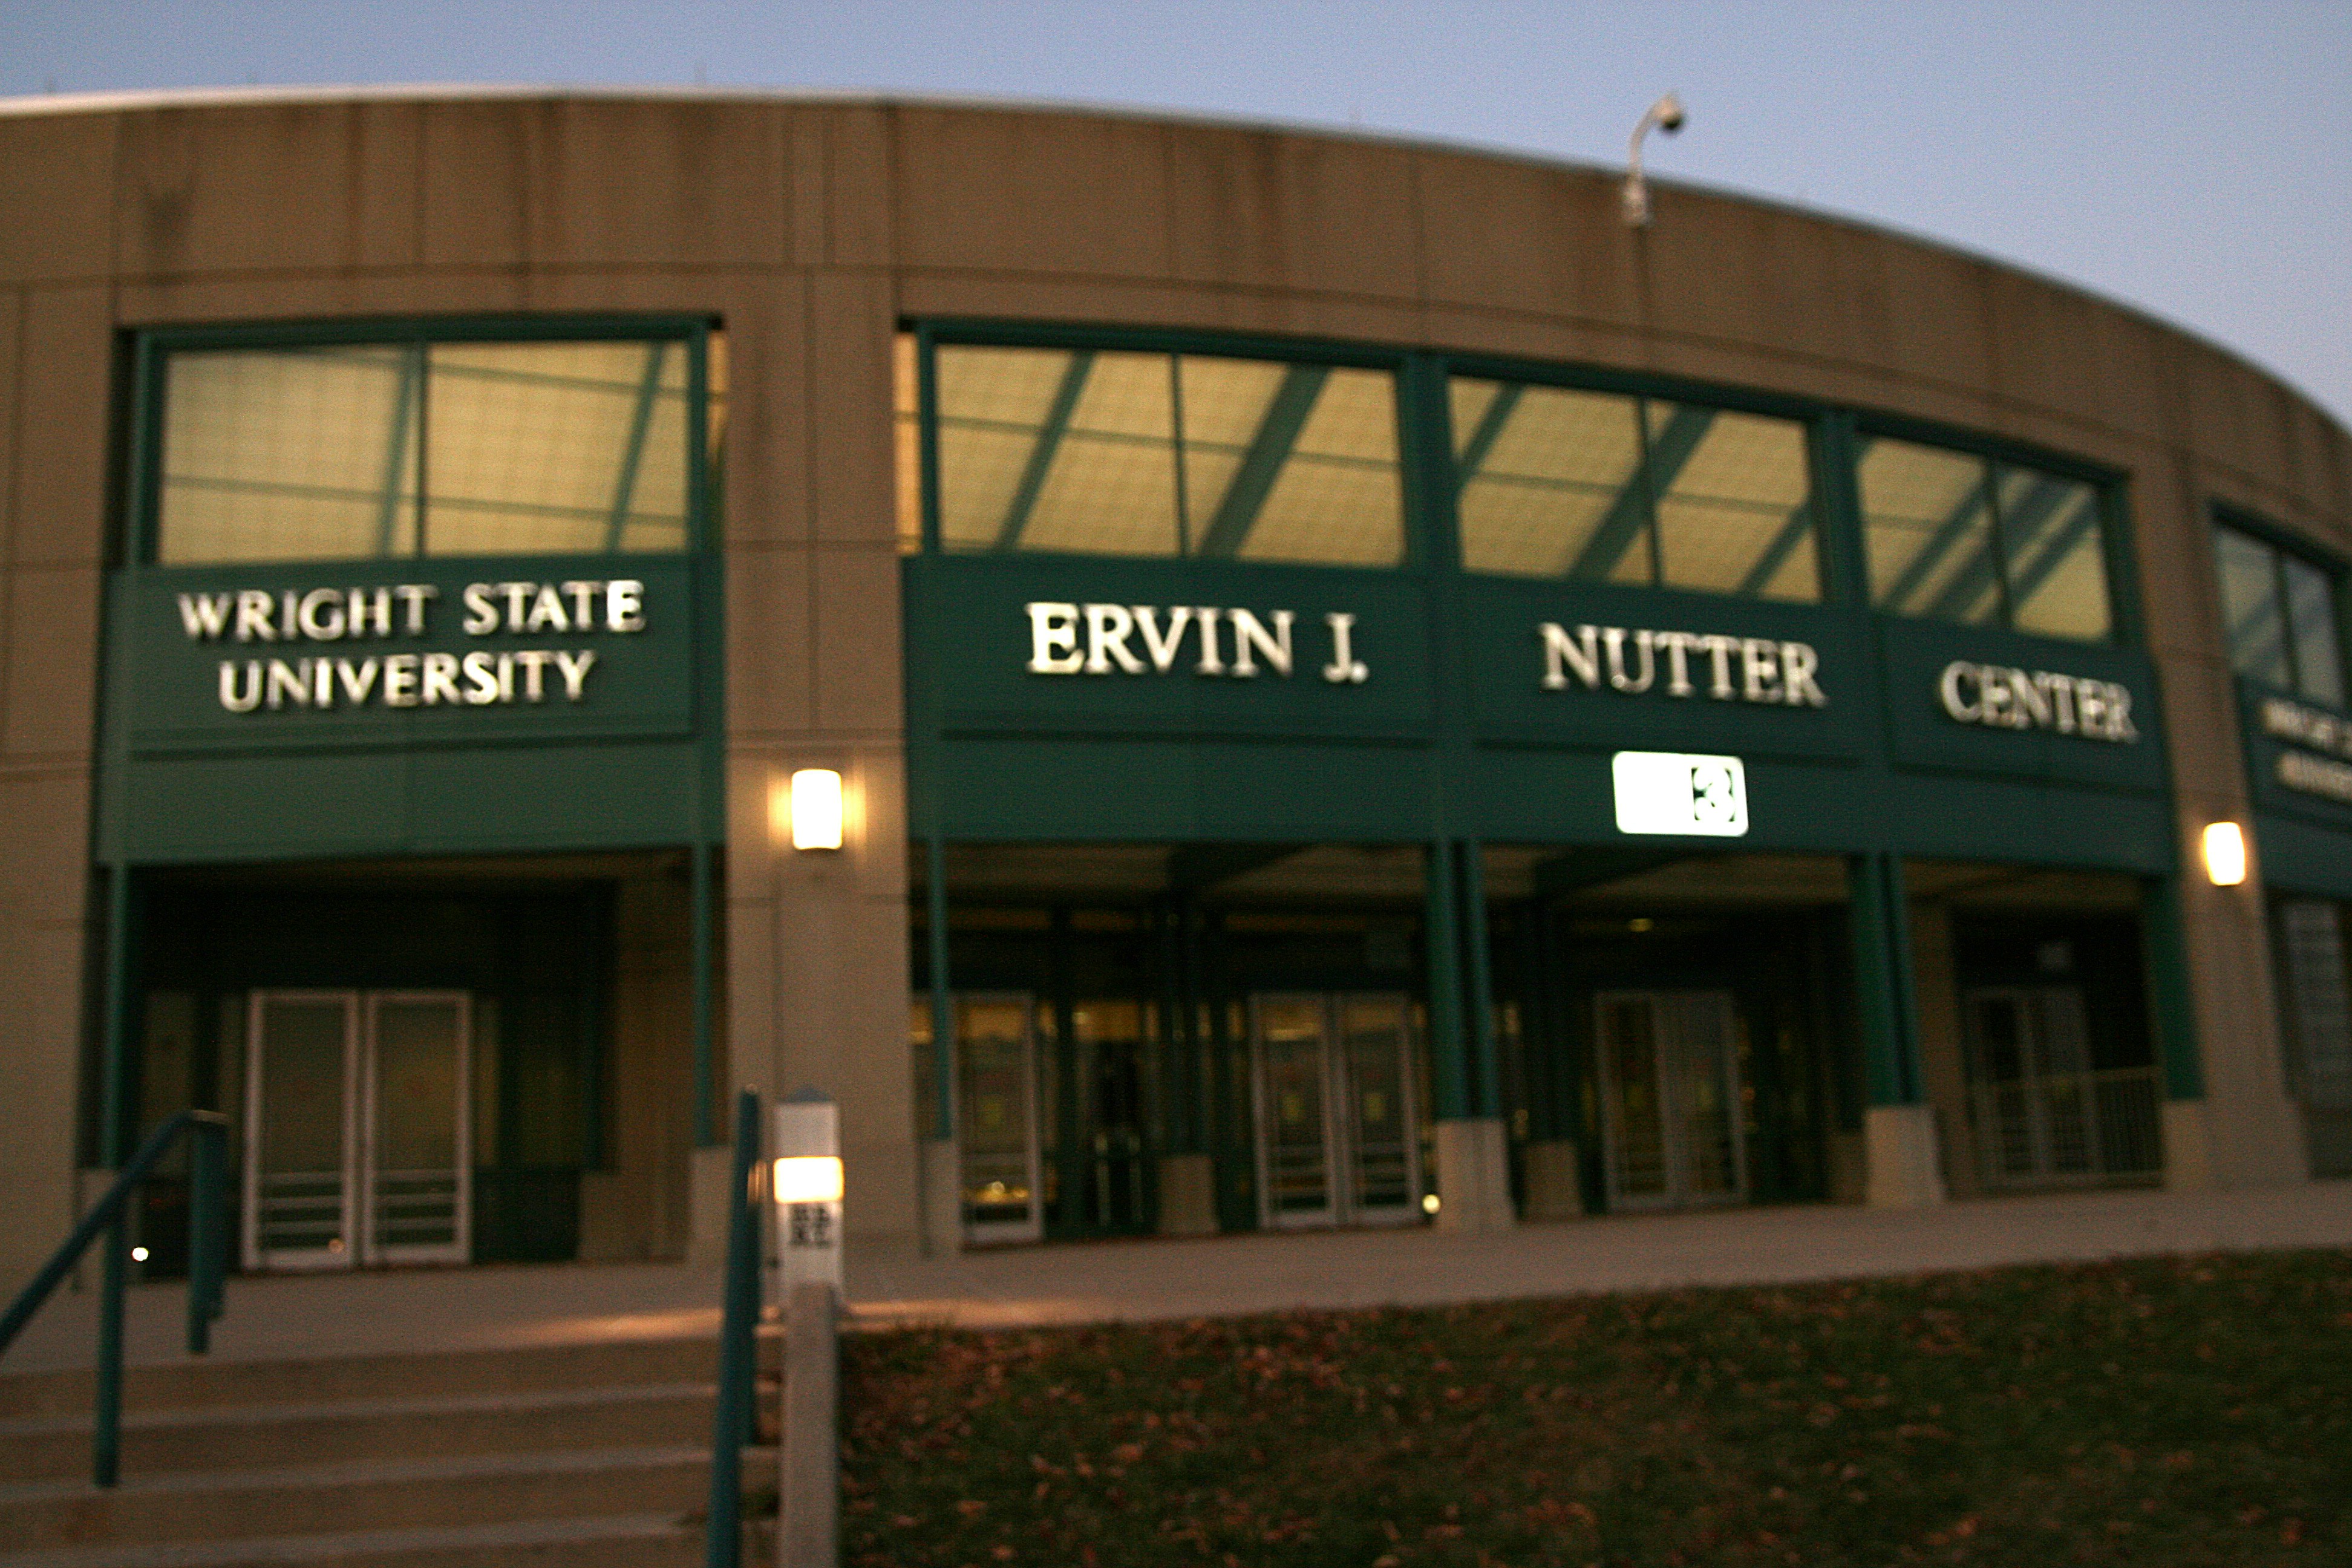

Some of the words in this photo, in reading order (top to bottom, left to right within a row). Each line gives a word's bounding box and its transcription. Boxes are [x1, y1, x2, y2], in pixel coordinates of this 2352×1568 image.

[177, 584, 438, 641] WRIGHT
[462, 579, 645, 635] STATE
[218, 649, 595, 712] UNIVERSITY
[1025, 601, 1294, 677] ERVIN
[1324, 612, 1368, 684] J.
[1540, 621, 1827, 707] NUTTER
[1941, 660, 2138, 743] CENTER
[1692, 765, 1735, 823] 3
